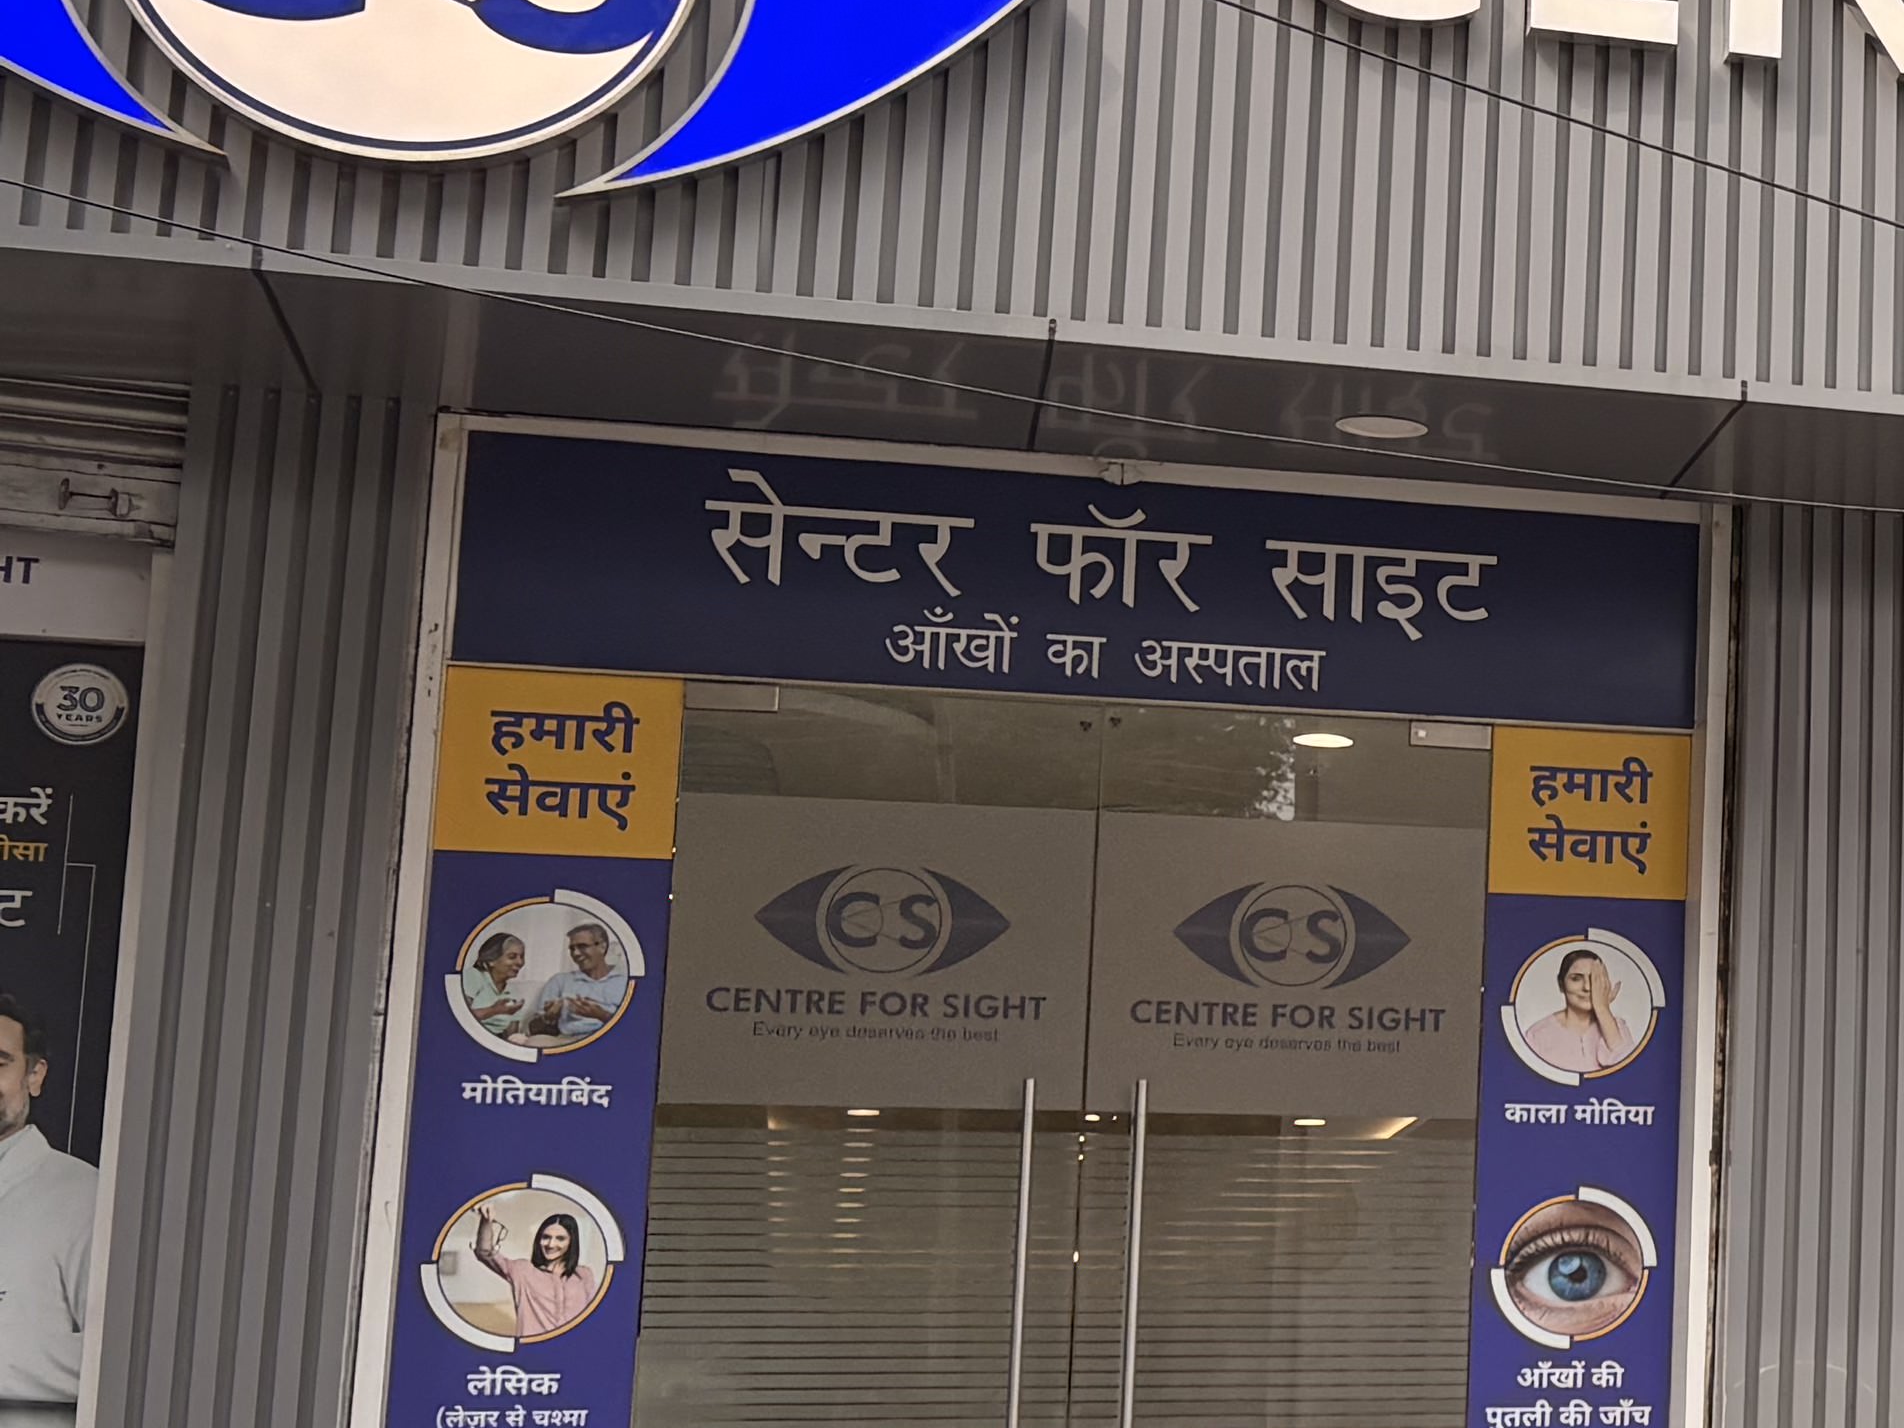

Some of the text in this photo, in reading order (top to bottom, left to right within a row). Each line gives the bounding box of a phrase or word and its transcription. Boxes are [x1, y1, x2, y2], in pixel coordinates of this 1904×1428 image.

[706, 468, 1497, 640] सेन्टर फॉर साइट
[885, 610, 1326, 694] आँखों का अस्पताल
[56, 685, 105, 713] 30
[490, 701, 640, 756] हमारी
[485, 763, 636, 832] सेवाएं
[1529, 756, 1653, 808] हमारी
[1527, 814, 1652, 875] सेवाएं
[705, 986, 1047, 1023] CENTRE FOR SIGHT
[1129, 1000, 1446, 1034] CENTRE FOR SIGHT
[461, 1075, 613, 1110] मोतियाबिंद
[1504, 1097, 1655, 1126] काला मोतिया
[466, 1365, 561, 1398] लेसिक
[1516, 1359, 1624, 1391] आँखों की
[532, 1406, 588, 1428] चश्मा
[1559, 1398, 1591, 1427] की
[1599, 1394, 1652, 1428] जाँच
